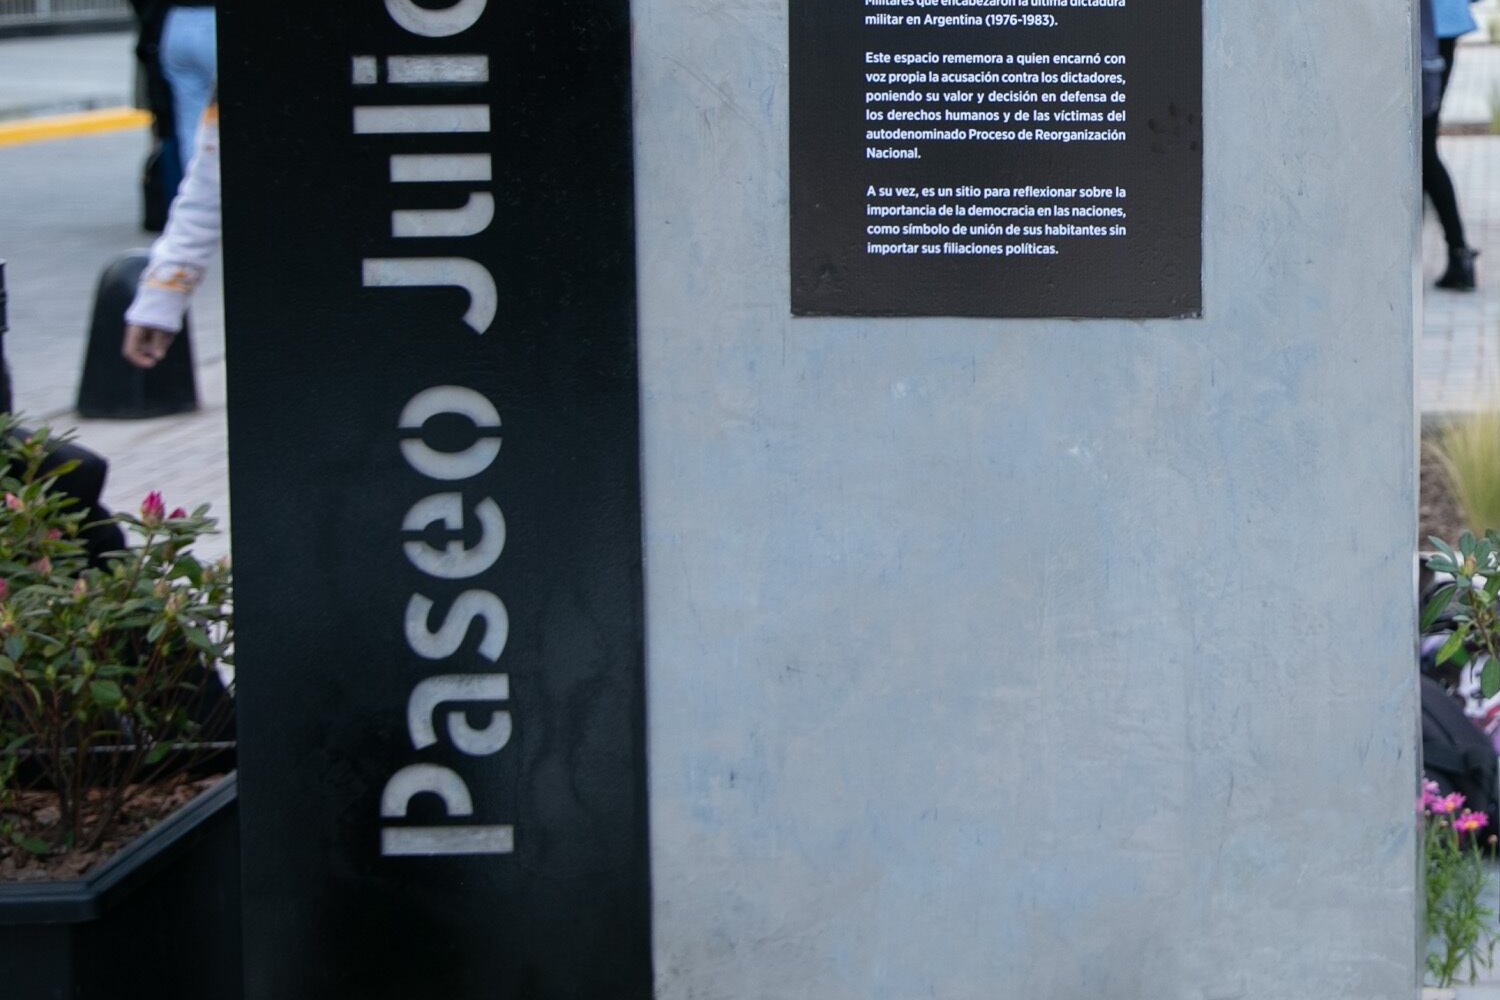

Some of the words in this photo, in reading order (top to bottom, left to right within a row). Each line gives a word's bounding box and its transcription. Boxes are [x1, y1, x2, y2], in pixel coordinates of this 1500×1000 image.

[864, 13, 904, 25] militar
[905, 16, 921, 26] en
[923, 13, 983, 28] Argentina
[984, 14, 1058, 28] (1976-1983).
[865, 52, 891, 64] Este
[893, 52, 940, 65] espacio
[942, 54, 1004, 64] rememora
[1005, 54, 1014, 64] a
[1016, 52, 1050, 66] quien
[1052, 52, 1102, 64] encarnó
[1104, 55, 1126, 64] con
[865, 73, 887, 83] voz
[888, 71, 927, 84] propia
[928, 71, 940, 83] la
[940, 71, 1000, 83] acusación
[1001, 72, 1040, 83] contra
[1040, 71, 1059, 84] los
[1060, 71, 1126, 85] dictadores,
[865, 90, 923, 104] poniendo
[925, 92, 940, 102] su
[943, 90, 974, 102] valor
[976, 92, 985, 104] y
[988, 90, 1038, 102] decisión
[1041, 92, 1057, 102] en
[1059, 90, 1107, 103] defensa
[1110, 90, 1126, 103] de
[866, 108, 884, 121] los
[886, 109, 942, 121] derechos
[944, 109, 1000, 121] humanos
[1002, 112, 1011, 123] y
[1014, 109, 1030, 122] de
[1033, 109, 1050, 122] las
[1053, 109, 1104, 122] víctimas
[1106, 110, 1126, 122] del
[865, 128, 967, 140] autodenominado
[968, 128, 1016, 140] Proceso
[1017, 128, 1034, 140] de
[1034, 128, 1126, 143] Reorganización
[866, 147, 921, 159] Nacional.
[866, 185, 877, 197] A
[878, 187, 893, 197] su
[895, 187, 919, 198] vez,
[921, 187, 936, 197] es
[937, 188, 953, 197] un
[955, 185, 982, 197] sitio
[983, 188, 1011, 199] para
[1012, 185, 1078, 198] reflexionar
[1079, 186, 1113, 198] sobre
[1115, 186, 1126, 198] la
[866, 204, 937, 218] importancia
[938, 204, 954, 216] de
[955, 204, 966, 216] la
[967, 204, 1036, 217] democracia
[1036, 207, 1052, 217] en
[1053, 204, 1070, 217] las
[1071, 205, 1126, 219] naciones,
[866, 225, 901, 235] como
[902, 223, 950, 235] símbolo
[951, 223, 968, 235] de
[969, 223, 1004, 236] unión
[1005, 223, 1021, 236] de
[1022, 226, 1043, 236] sus
[1044, 224, 1108, 236] habitantes
[1108, 224, 1127, 236] sin
[867, 242, 920, 256] importar
[921, 244, 942, 254] sus
[943, 242, 1004, 254] filiaciones
[1005, 242, 1059, 256] políticas.
[381, 385, 514, 856] Paseo
